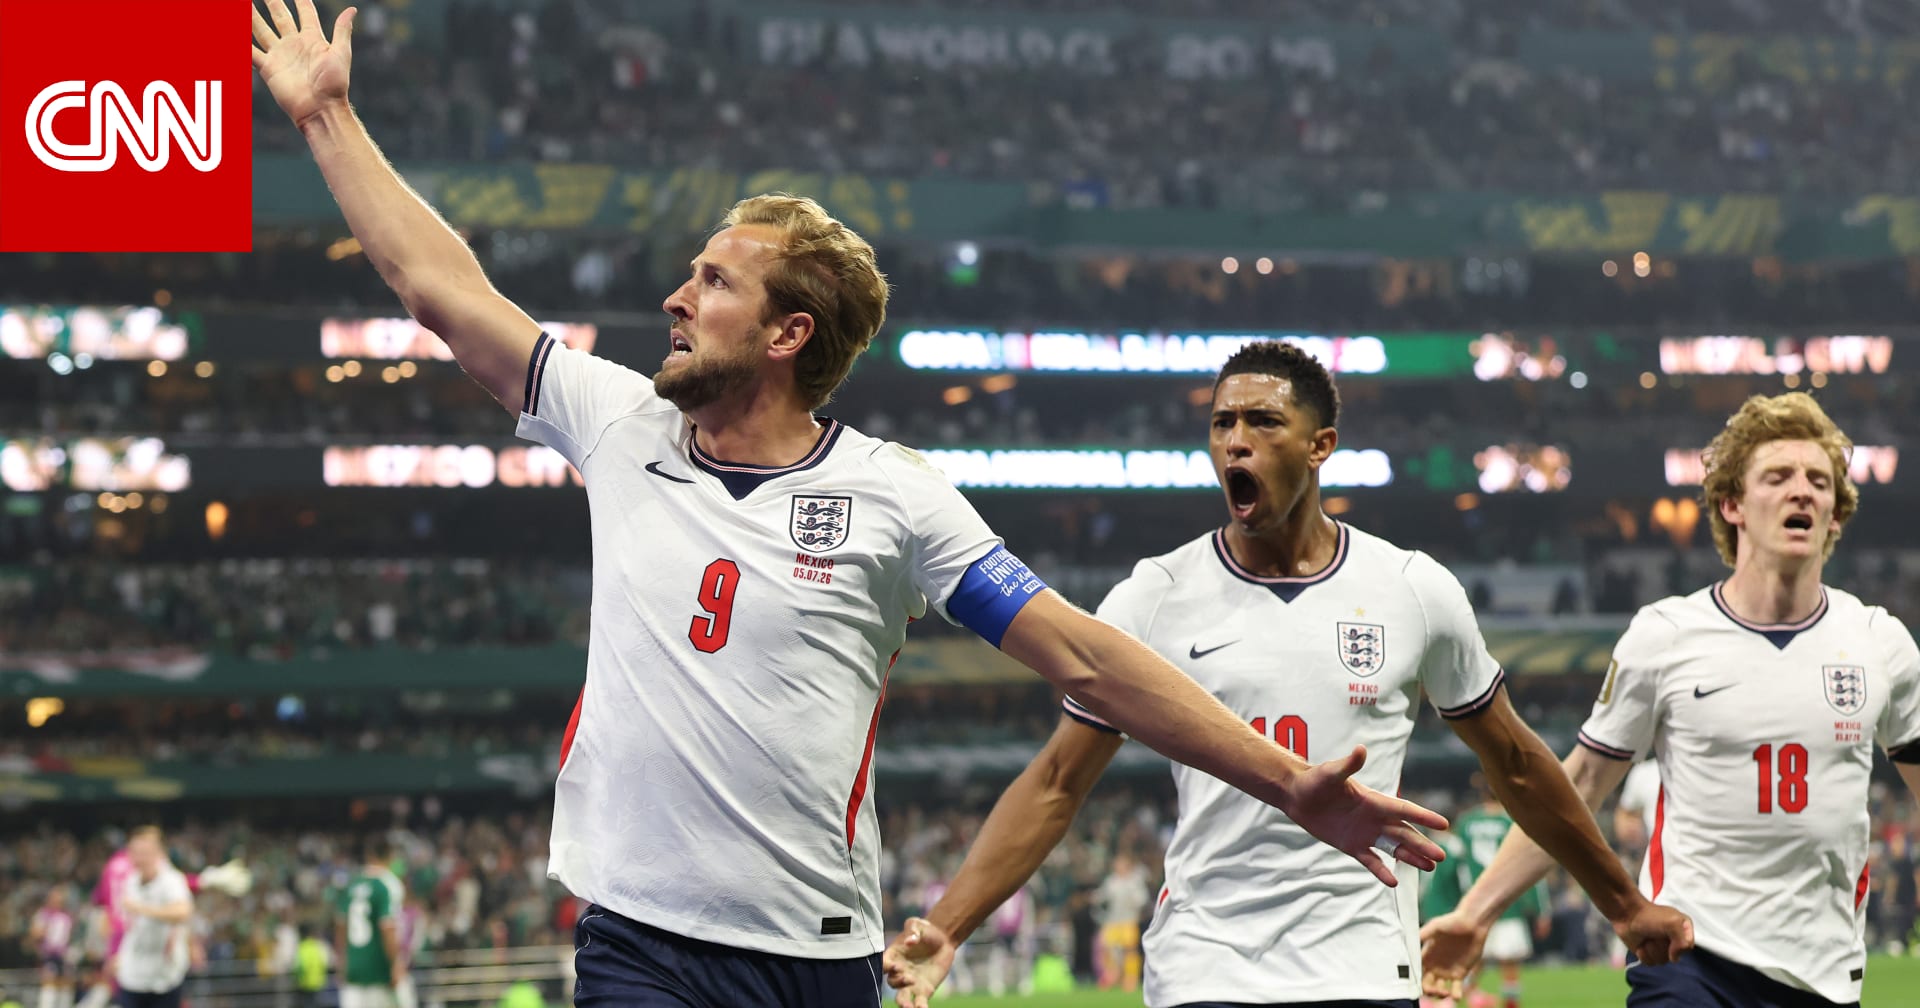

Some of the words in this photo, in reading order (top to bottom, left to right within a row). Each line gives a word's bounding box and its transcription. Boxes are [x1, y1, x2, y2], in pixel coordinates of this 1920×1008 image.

[795, 552, 834, 570] MEXICO
[987, 556, 1025, 585] UNITE
[793, 567, 832, 585] 05.07.26
[688, 558, 741, 654] 9
[1349, 682, 1378, 694] MEXICO
[1753, 743, 1808, 814] 18
